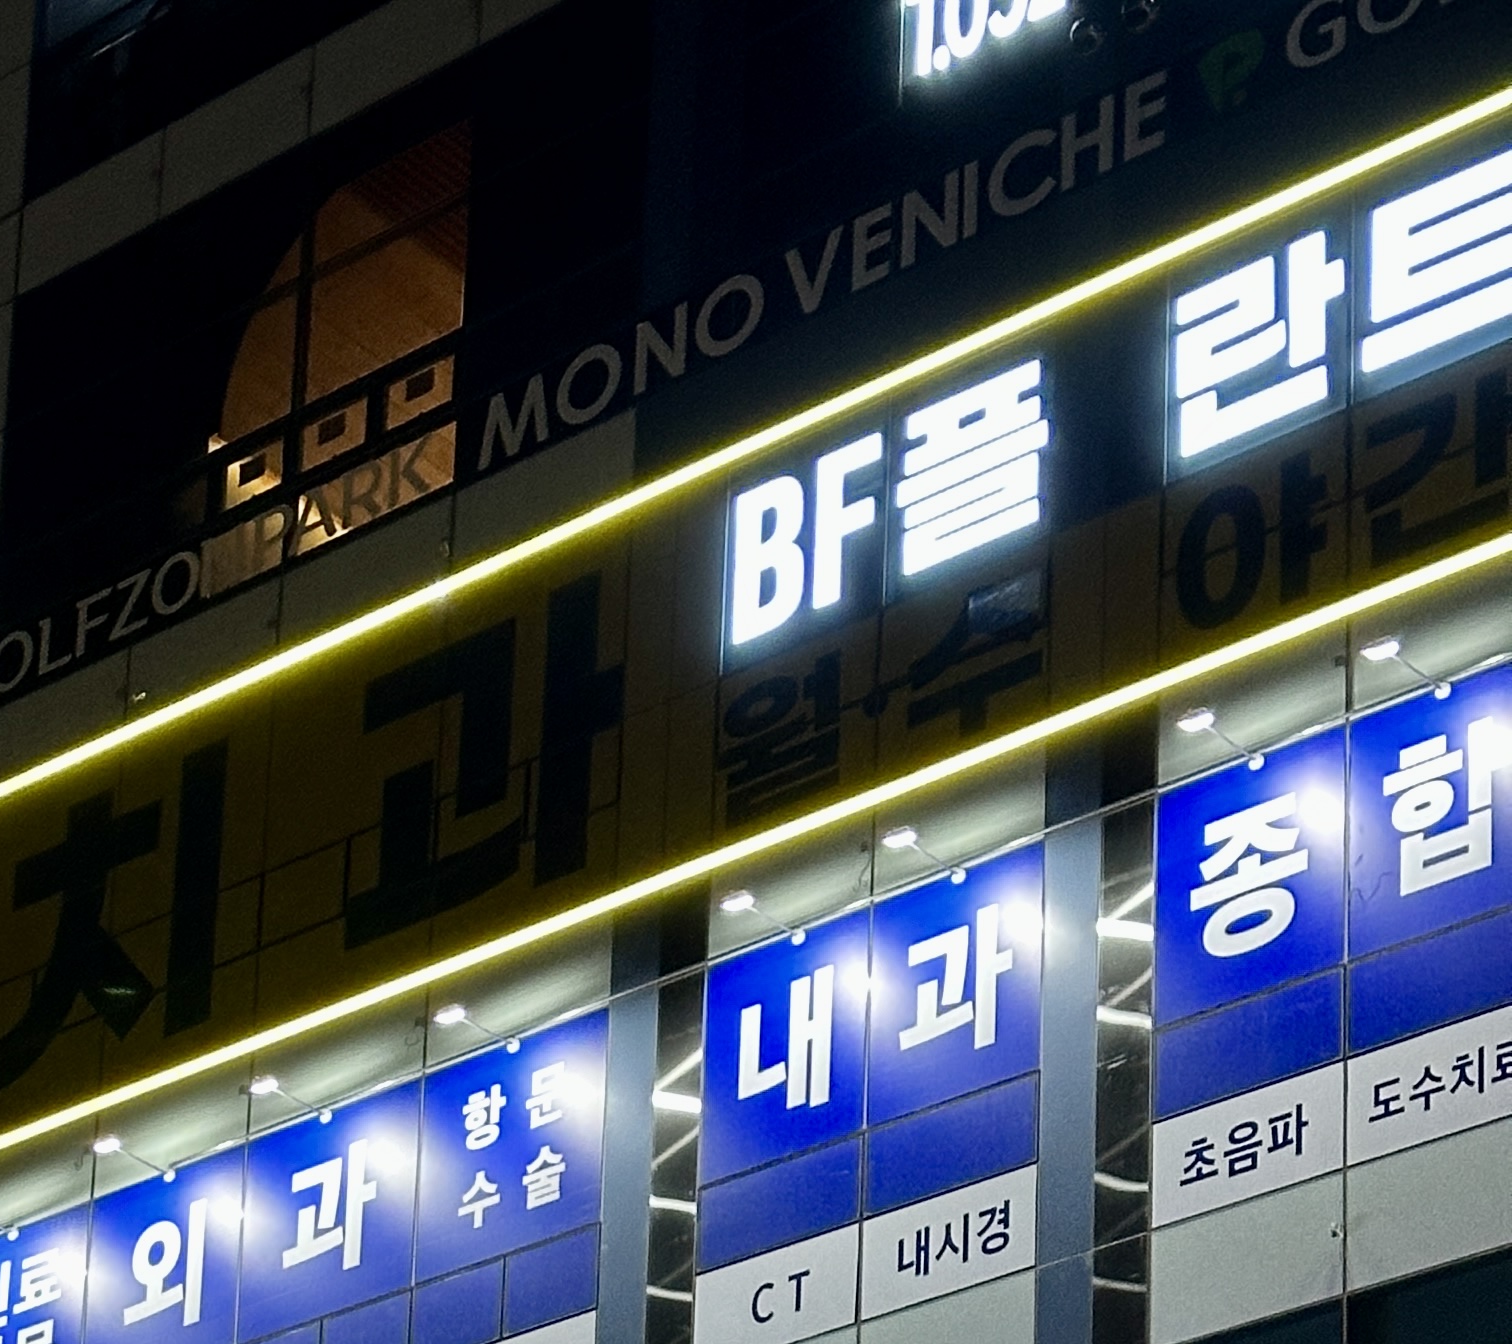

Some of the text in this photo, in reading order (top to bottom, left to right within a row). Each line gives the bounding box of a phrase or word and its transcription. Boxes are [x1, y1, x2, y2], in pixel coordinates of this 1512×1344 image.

[476, 276, 764, 473] MONO
[786, 71, 1169, 316] VENICHE
[736, 904, 1013, 1111] 내과
[456, 1146, 568, 1230] 수술
[1179, 1103, 1311, 1190] 초음파
[896, 1198, 1014, 1278] 내시경
